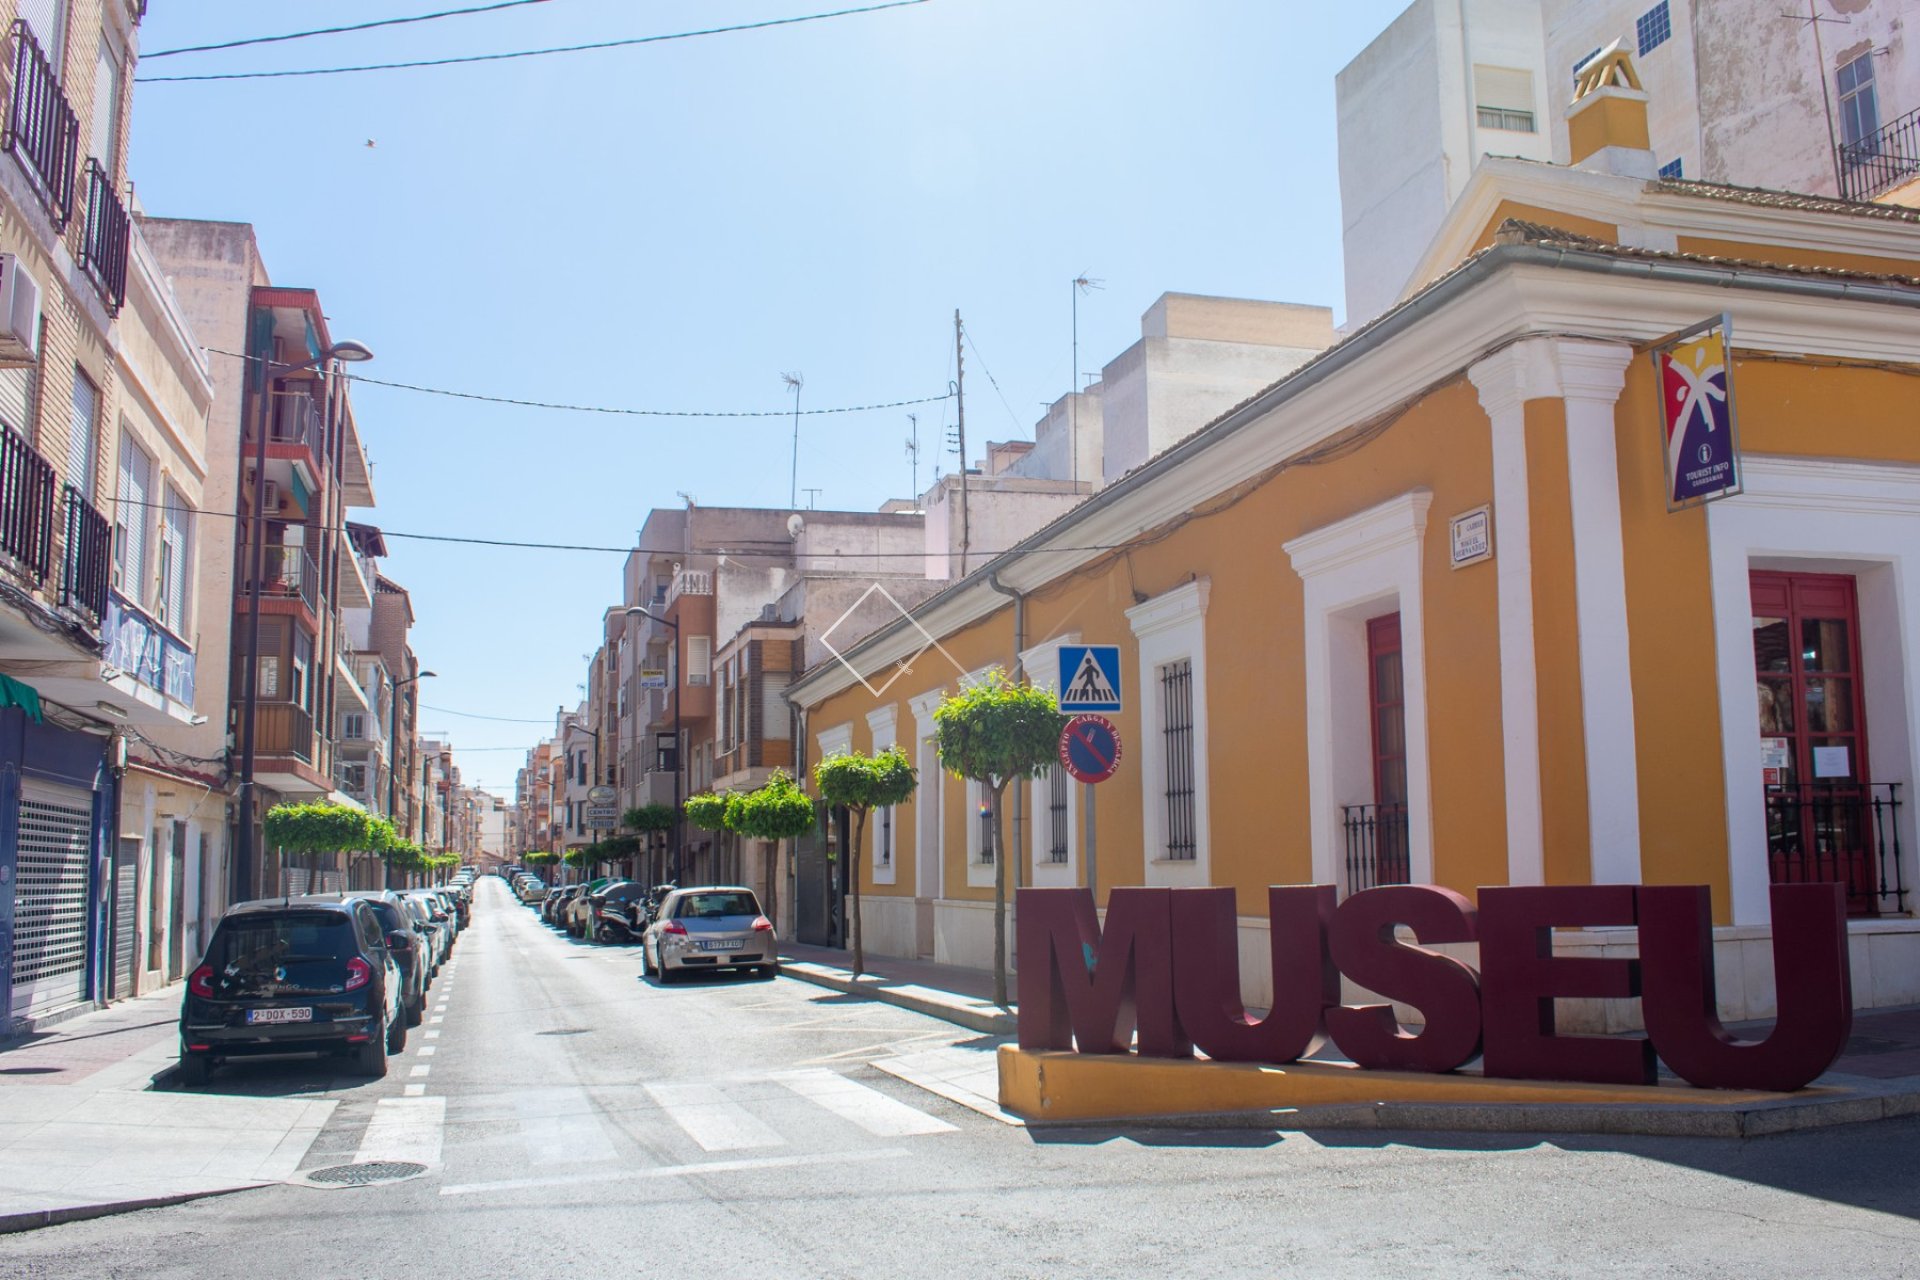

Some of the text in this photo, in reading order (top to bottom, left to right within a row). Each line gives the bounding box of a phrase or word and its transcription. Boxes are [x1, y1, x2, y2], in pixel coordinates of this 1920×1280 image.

[1686, 462, 1729, 481] TOURIST INFO
[1076, 714, 1104, 725] CARGA
[1061, 733, 1078, 776] EXCEPTO
[1017, 882, 1853, 1092] MUSEU
